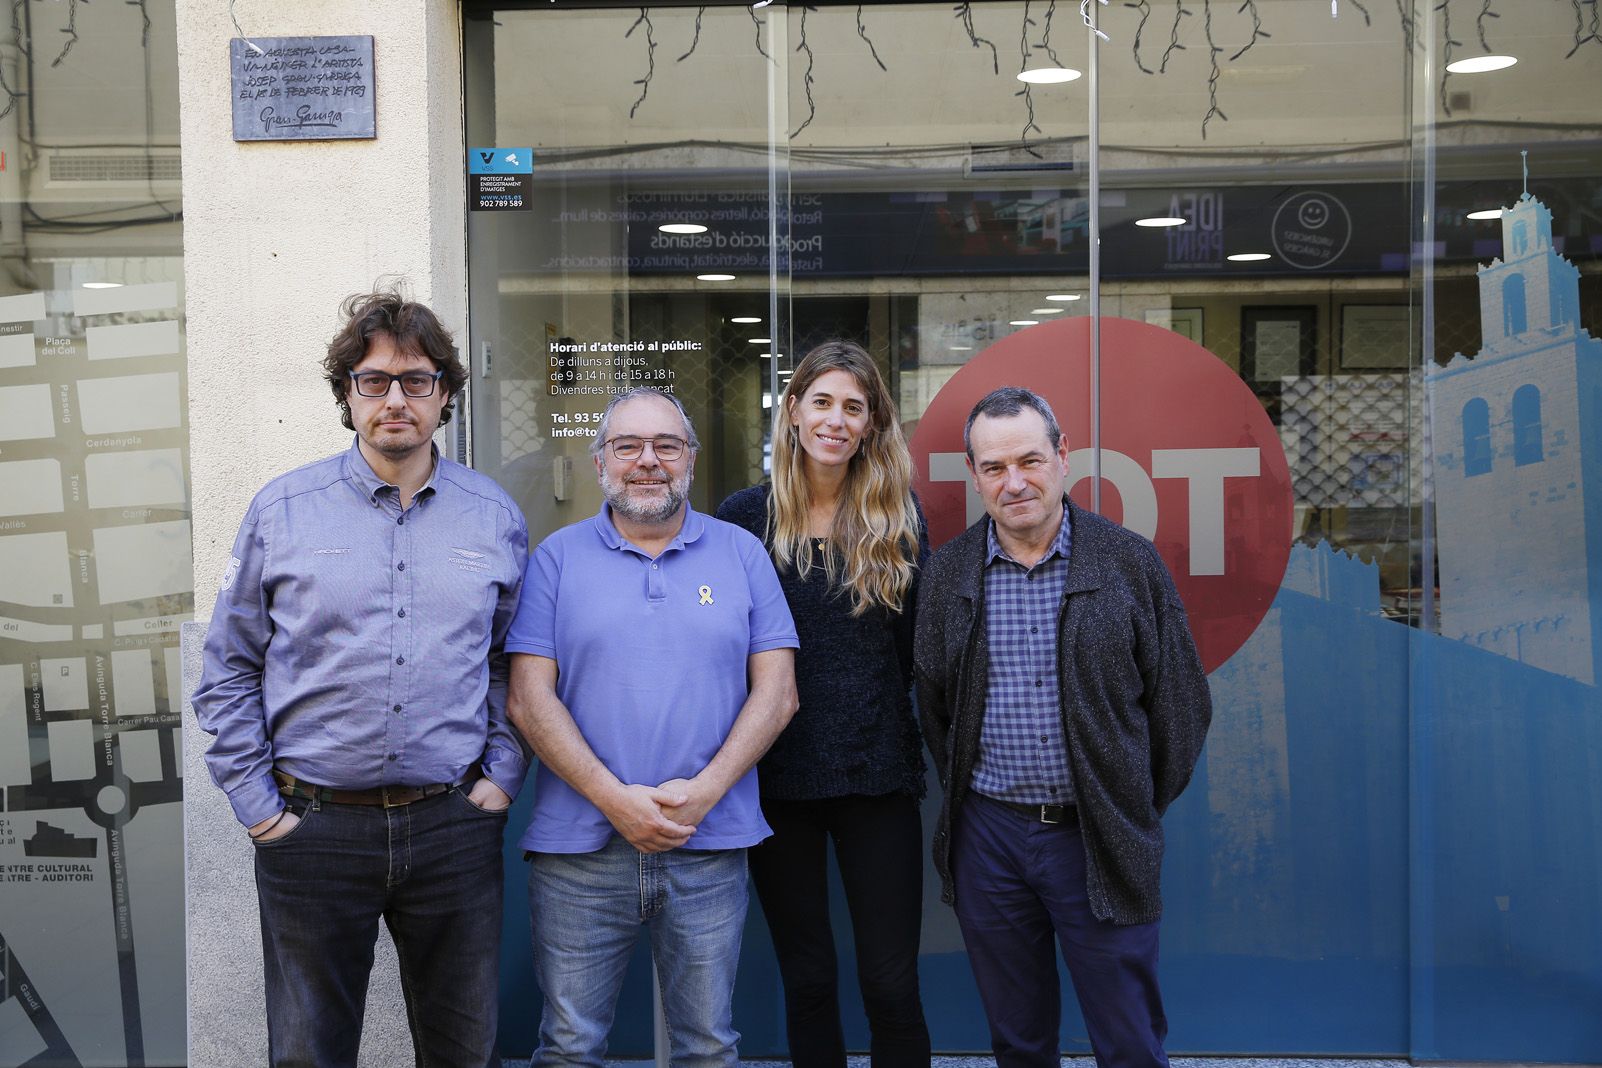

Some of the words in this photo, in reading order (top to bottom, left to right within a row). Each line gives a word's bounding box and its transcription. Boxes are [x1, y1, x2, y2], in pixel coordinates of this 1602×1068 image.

[46, 337, 72, 346] Plaça
[550, 342, 587, 352] Horari
[590, 341, 644, 352] d'atenció
[648, 341, 658, 350] al
[662, 340, 702, 352] públic:
[42, 348, 56, 356] del
[57, 347, 76, 356] Coll
[550, 357, 564, 366] De
[568, 356, 602, 366] dilluns
[614, 356, 648, 368] dijous,
[550, 371, 564, 380] de
[566, 372, 574, 380] 9
[586, 371, 596, 380] 14
[600, 370, 606, 380] h
[614, 370, 628, 380] de
[630, 370, 642, 380] 15
[654, 370, 666, 379] 18
[668, 370, 674, 378] h
[551, 385, 604, 396] Divendres
[60, 384, 71, 424] Passeig
[551, 413, 572, 423] Tel.
[574, 413, 590, 423] 93
[552, 428, 599, 438] info@to
[86, 436, 142, 448] Cerdanyola
[4, 622, 19, 632] del
[144, 619, 173, 630] Celler
[96, 656, 106, 702] Avinguda
[101, 702, 110, 730] Torre
[118, 716, 142, 726] Carrer
[144, 715, 160, 724] Pau
[160, 714, 180, 722] Casa
[104, 732, 113, 766] Blanca
[38, 864, 92, 872] CULTURAL
[42, 874, 94, 882] AUDITORI
[110, 830, 122, 874] Avinguda
[118, 906, 128, 940] Blanca
[20, 984, 40, 1010] Gaudí
